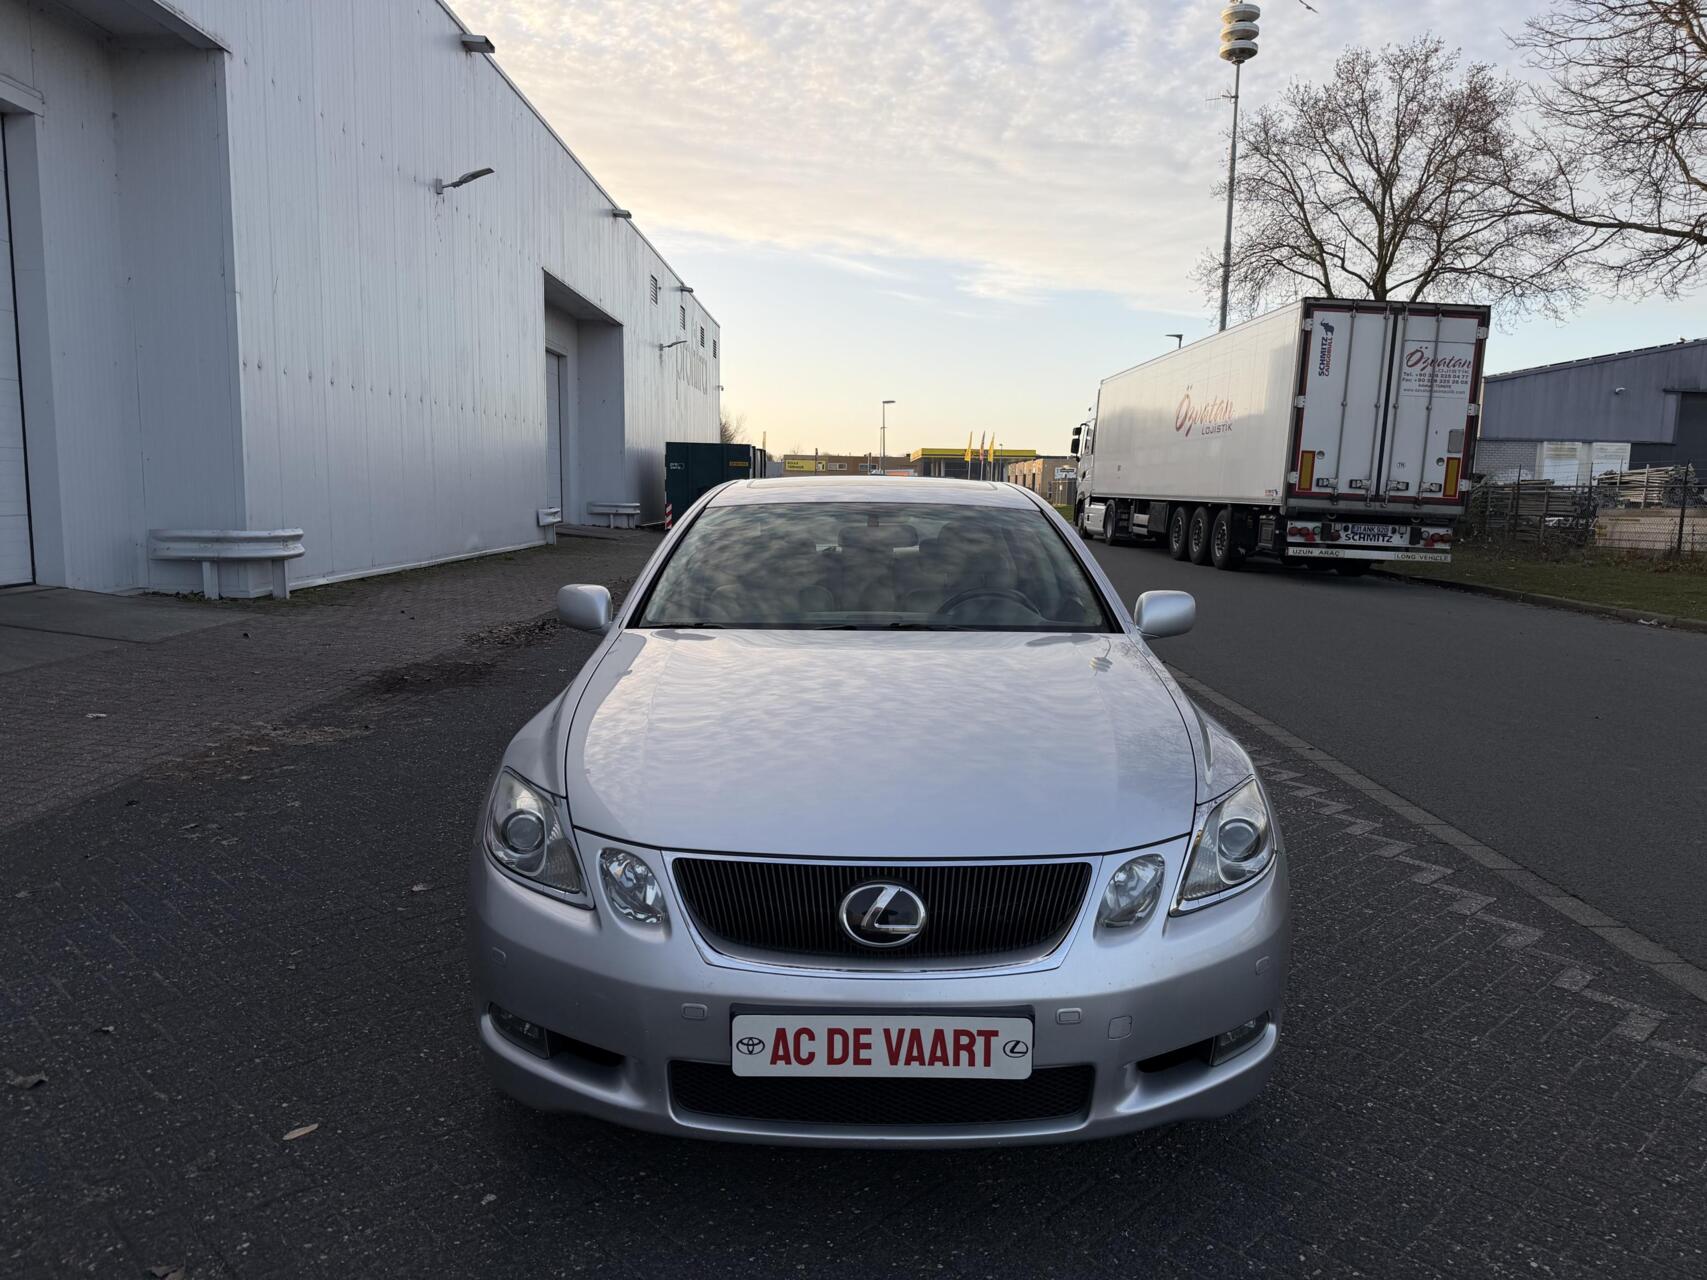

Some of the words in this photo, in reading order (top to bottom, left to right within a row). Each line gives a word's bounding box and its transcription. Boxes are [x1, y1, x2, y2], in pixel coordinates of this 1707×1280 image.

[1318, 336, 1328, 377] SCHMITZ
[1344, 532, 1393, 543] SCHMITZ
[769, 1027, 816, 1066] AC
[826, 1027, 873, 1066] DE
[883, 1027, 1000, 1068] VAART
